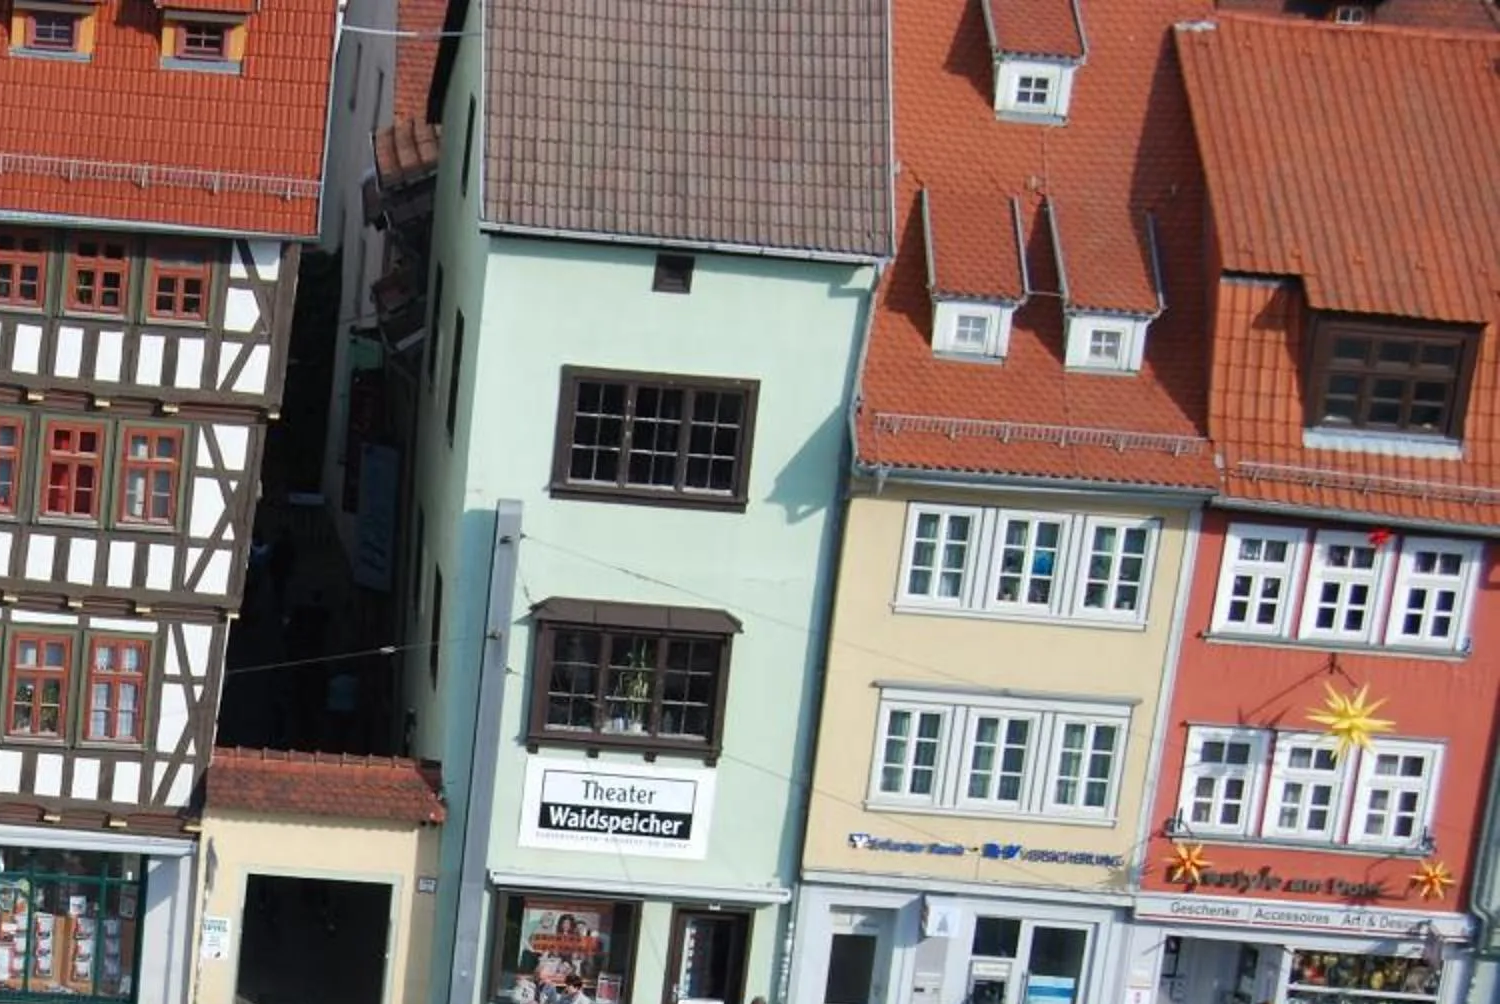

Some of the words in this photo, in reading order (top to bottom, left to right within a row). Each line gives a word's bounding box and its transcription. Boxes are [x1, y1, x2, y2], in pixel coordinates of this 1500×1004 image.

[582, 779, 657, 805] Theater
[549, 805, 683, 836] Waidspeicher
[1170, 901, 1239, 918] Geschenke
[1254, 907, 1330, 926] Accessoires
[1379, 914, 1423, 931] Desi
